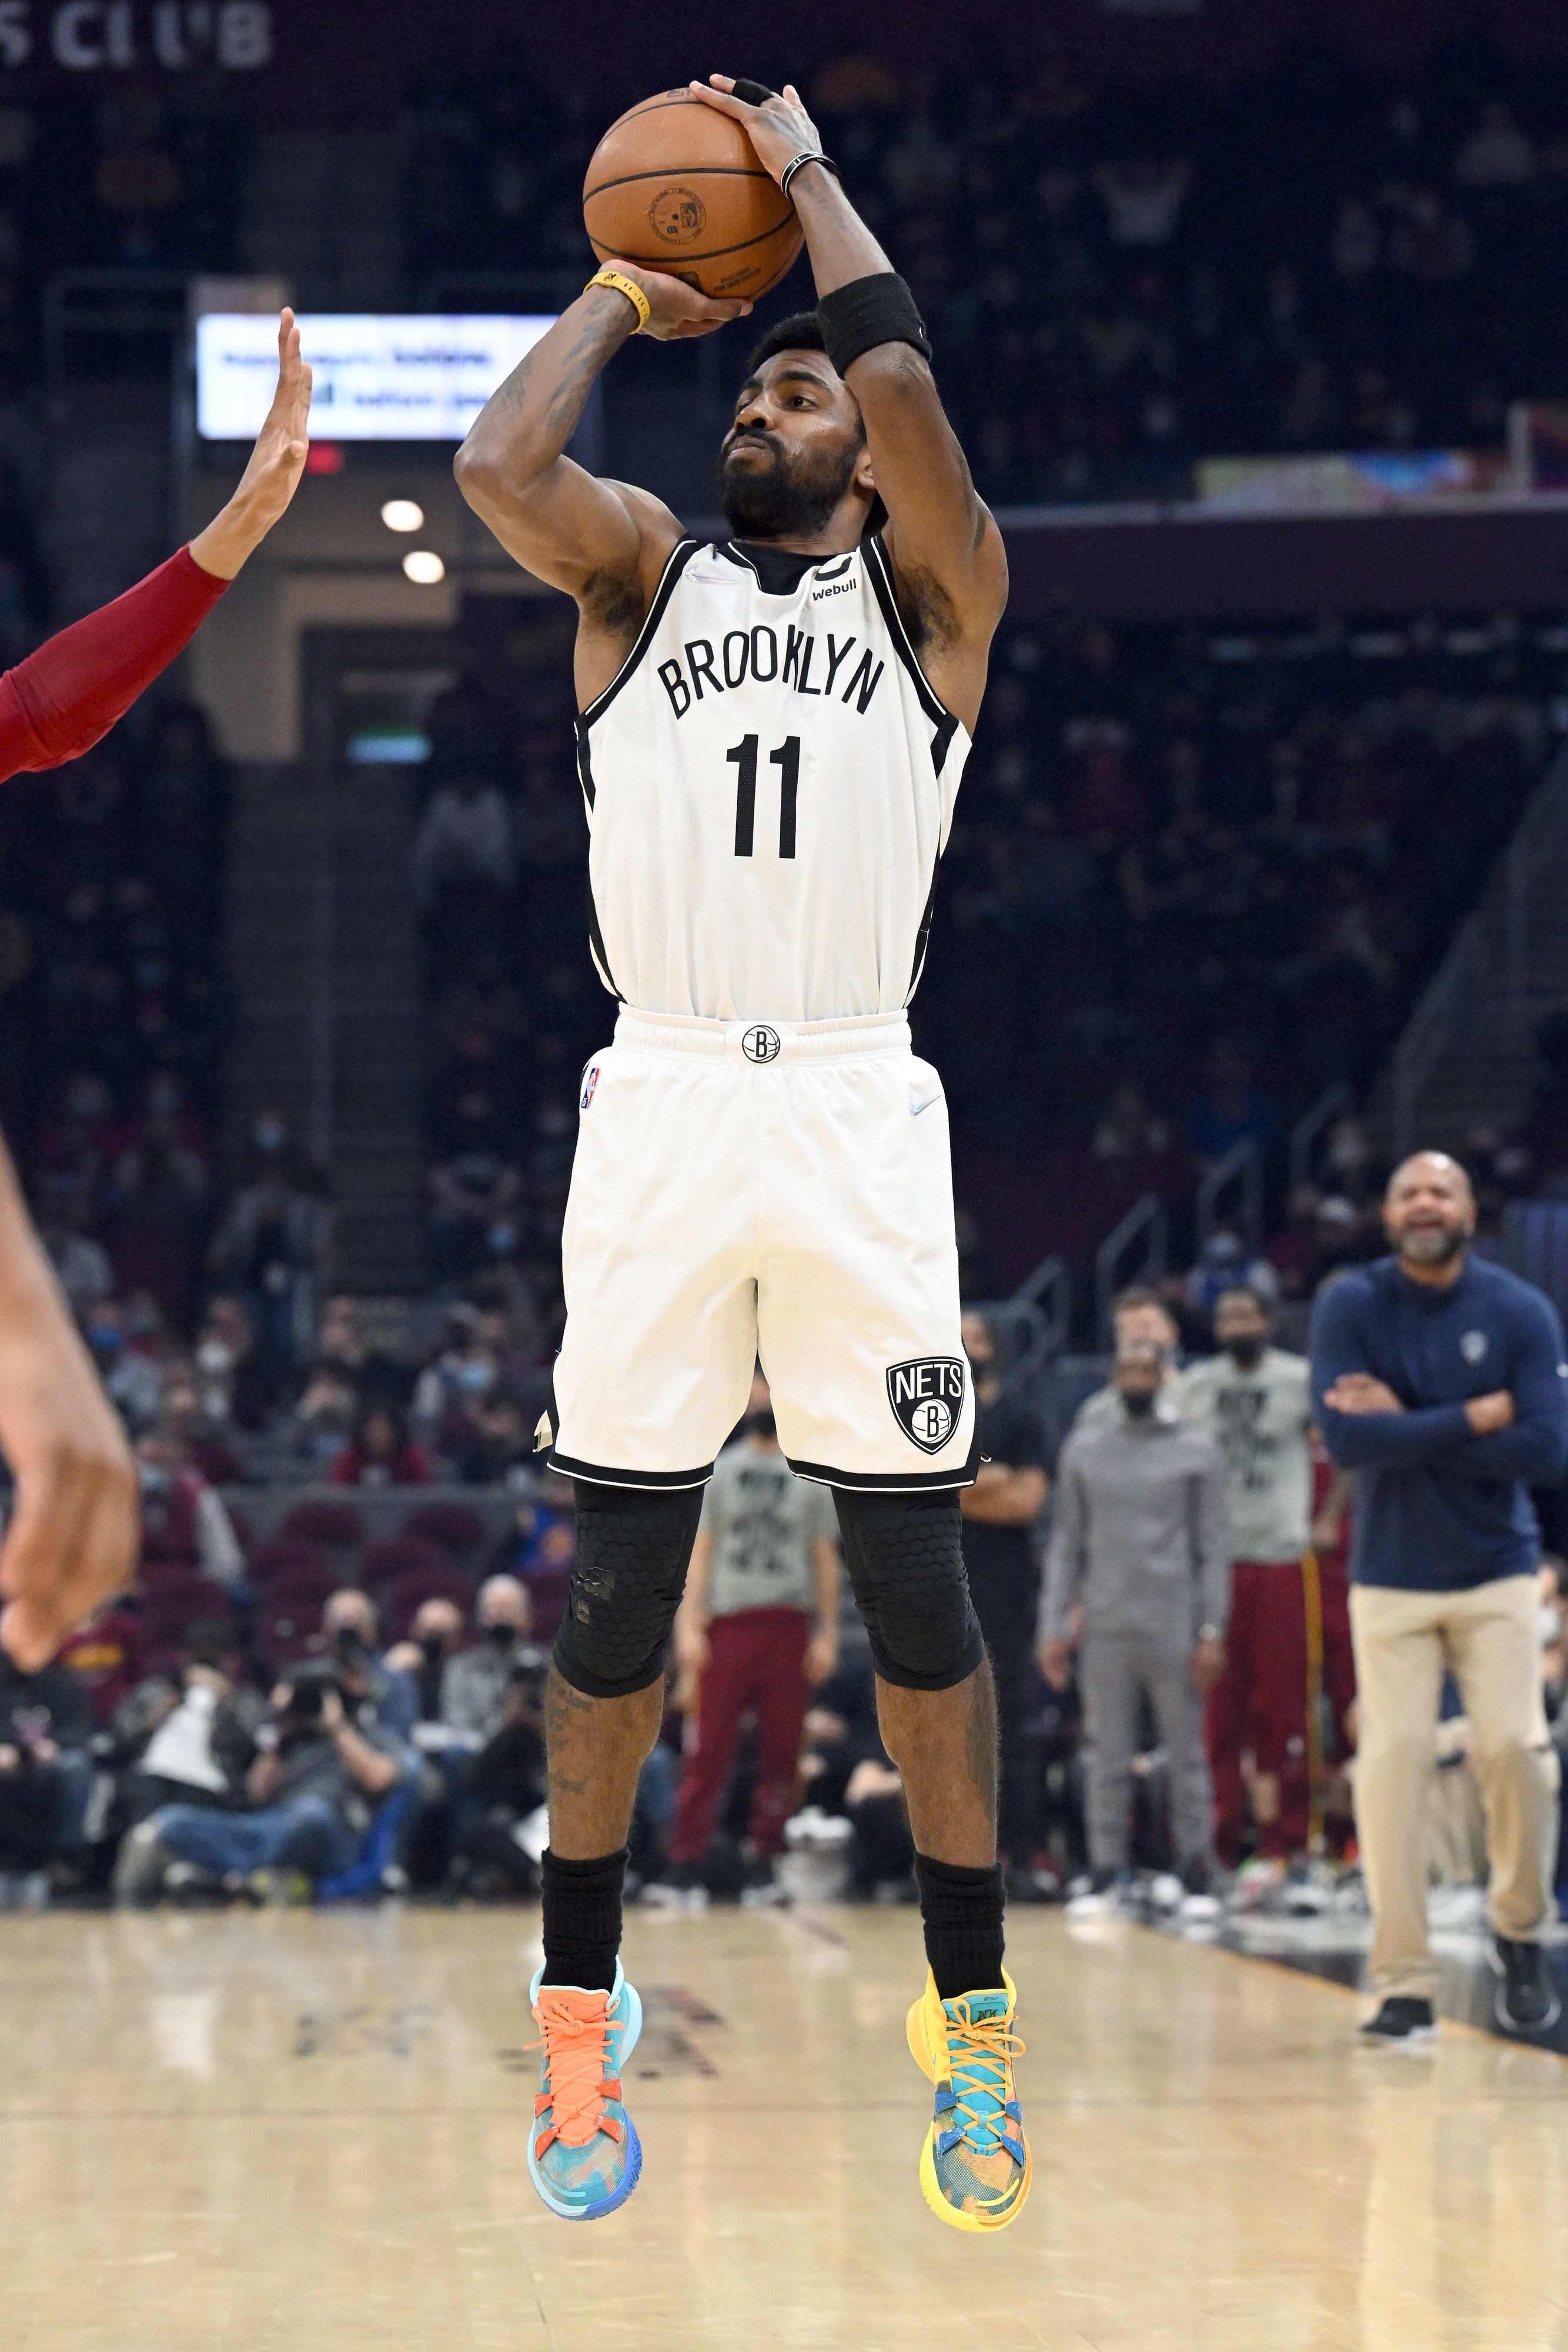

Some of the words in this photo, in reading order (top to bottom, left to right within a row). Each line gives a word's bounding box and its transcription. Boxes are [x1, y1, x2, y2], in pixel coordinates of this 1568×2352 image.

[657, 624, 884, 720] BROOKLYN
[726, 734, 800, 859] 11
[755, 1031, 767, 1057] B
[896, 1364, 962, 1404] NETS
[927, 1405, 939, 1438] B
